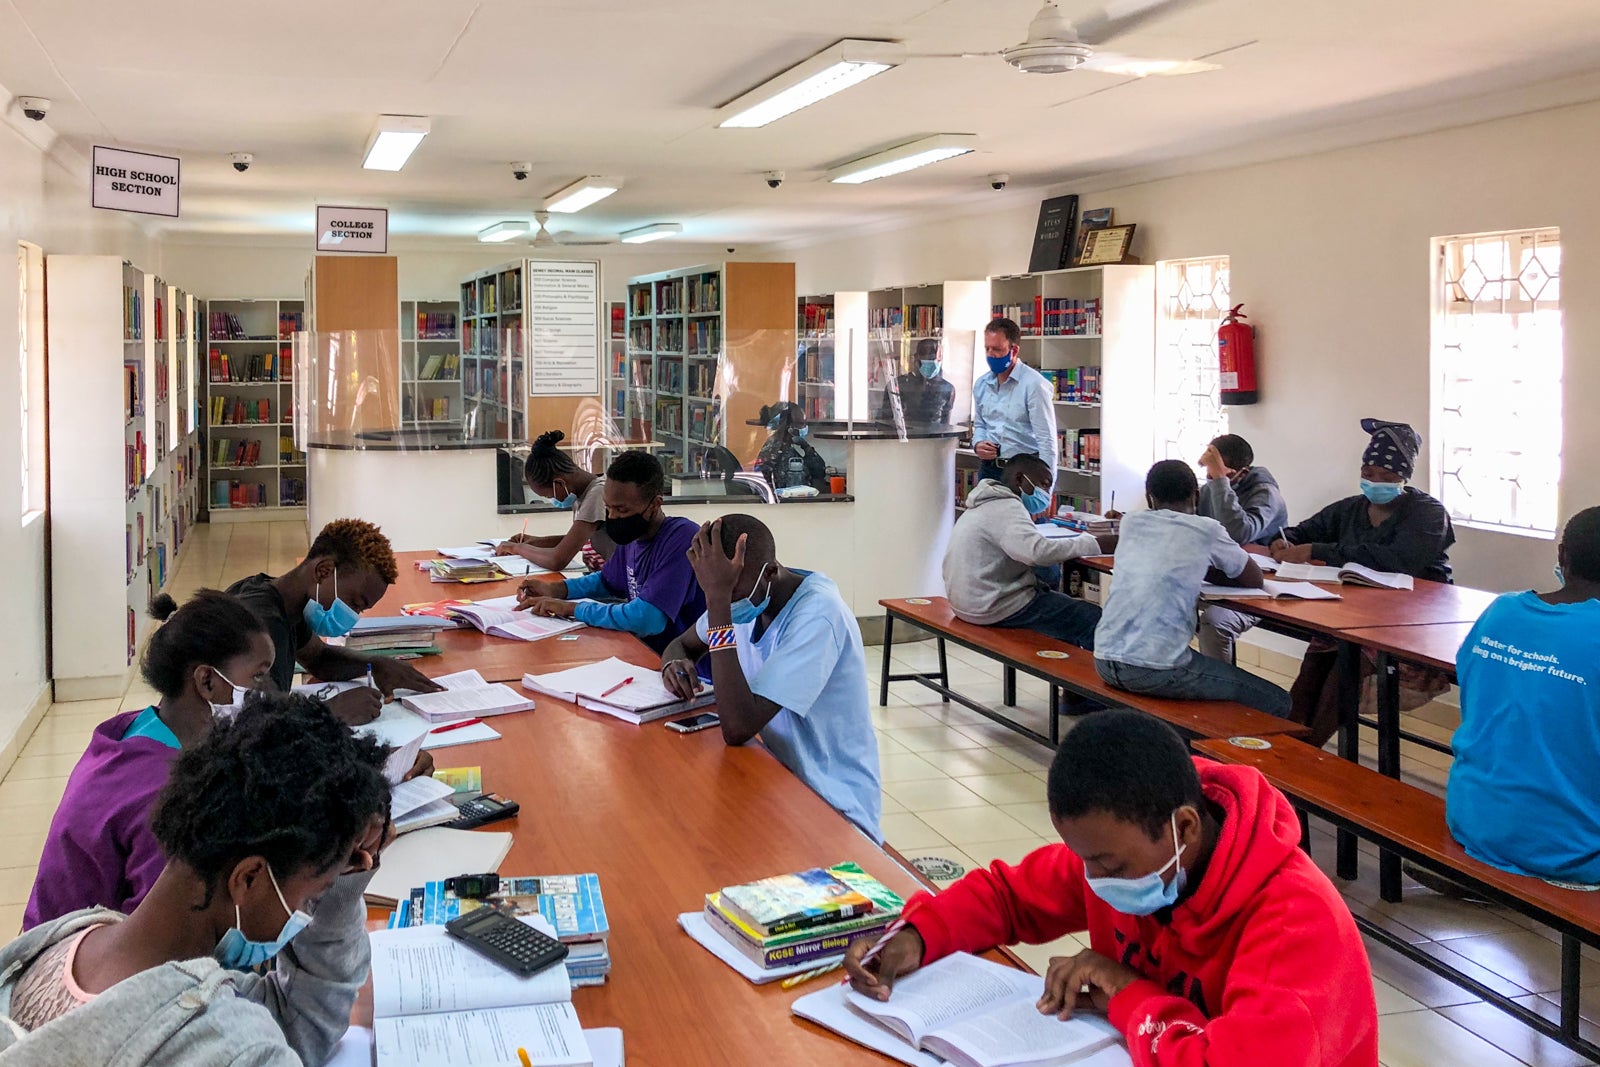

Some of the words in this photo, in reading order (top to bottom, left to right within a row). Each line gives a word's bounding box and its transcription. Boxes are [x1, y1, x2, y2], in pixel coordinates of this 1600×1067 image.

[96, 165, 127, 179] HIGH
[130, 170, 177, 186] SCHOOL
[111, 181, 162, 197] SECTION
[330, 220, 374, 229] COLLEGE
[331, 229, 373, 239] SECTION
[1481, 635, 1507, 650] Water
[1507, 644, 1523, 656] for
[1522, 651, 1560, 665] schools.
[1490, 652, 1503, 662] on
[1508, 656, 1547, 673] brighter
[1547, 665, 1588, 686] future.
[769, 947, 794, 961] KCSE
[796, 942, 821, 955] Mirror
[822, 937, 849, 949] Biology
